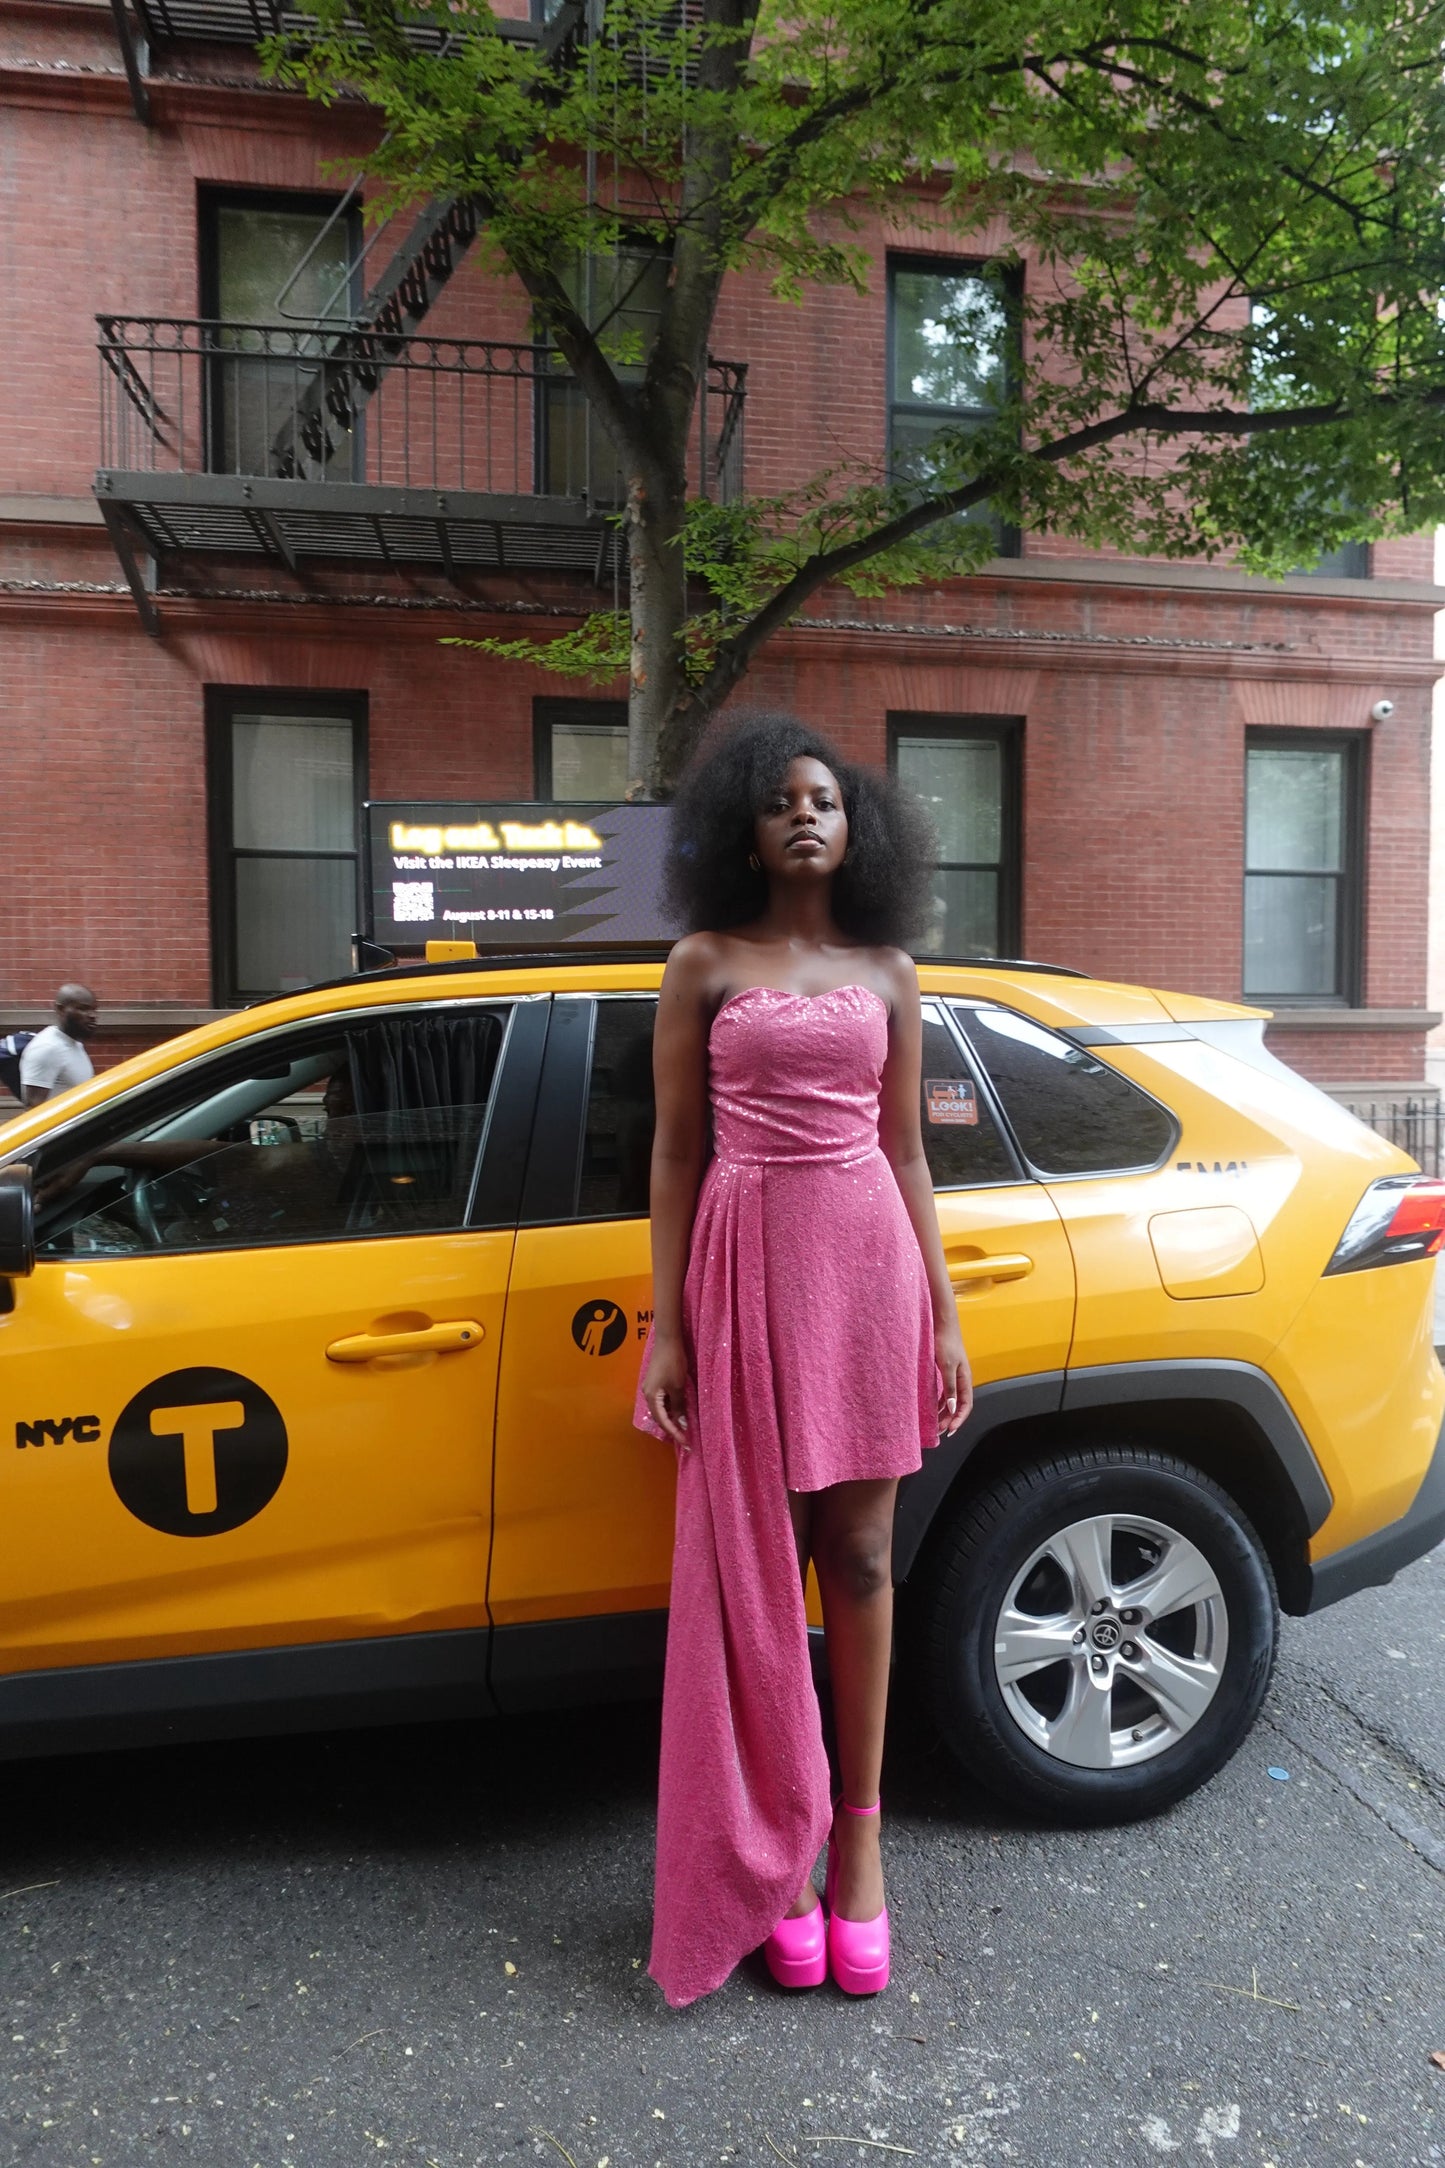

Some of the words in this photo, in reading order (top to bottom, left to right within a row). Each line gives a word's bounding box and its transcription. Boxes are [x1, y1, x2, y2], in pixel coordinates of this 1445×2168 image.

[393, 856, 428, 869] Visit
[429, 856, 454, 869] the
[456, 856, 489, 869] IKEA
[490, 855, 561, 871] Sleepeasy
[562, 856, 602, 868] Event
[443, 910, 486, 923] August
[487, 910, 511, 920] 8-11
[512, 910, 523, 920] &
[524, 909, 554, 920] 15-18
[930, 1101, 974, 1112] LOOK!
[15, 1415, 100, 1449] NYC
[150, 1400, 245, 1514] T
